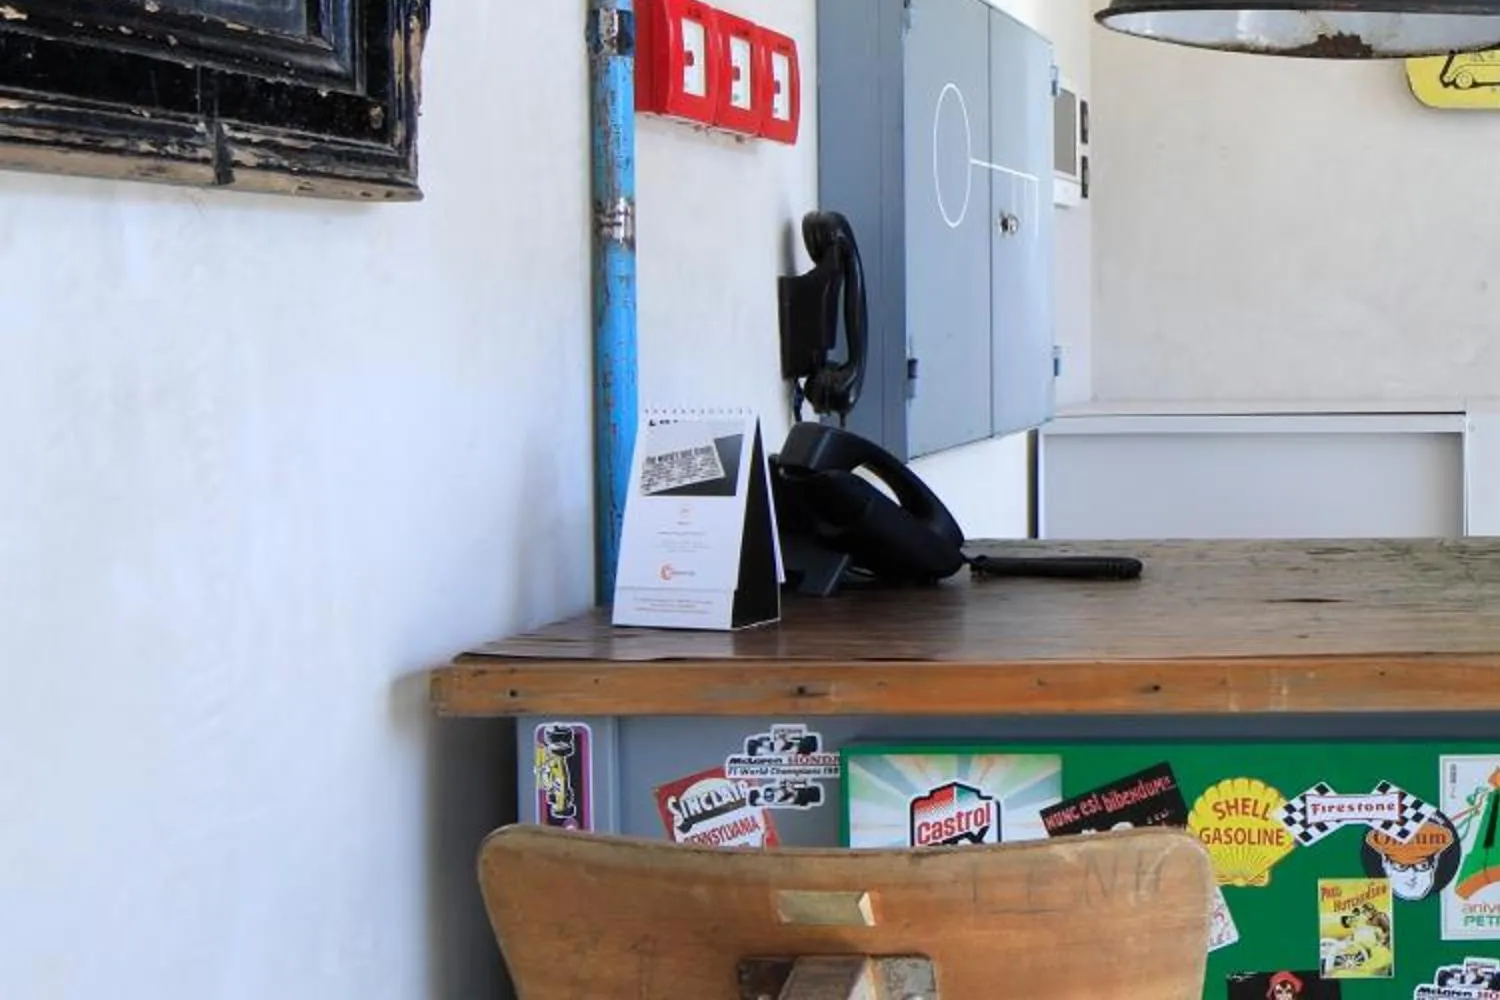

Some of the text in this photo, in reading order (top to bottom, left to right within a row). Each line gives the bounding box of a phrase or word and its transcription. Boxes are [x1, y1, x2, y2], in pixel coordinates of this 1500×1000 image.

[1212, 798, 1271, 821] SHELL
[1310, 801, 1396, 815] Firestone
[917, 802, 990, 845] Castrol
[1200, 827, 1285, 846] GASOLINE
